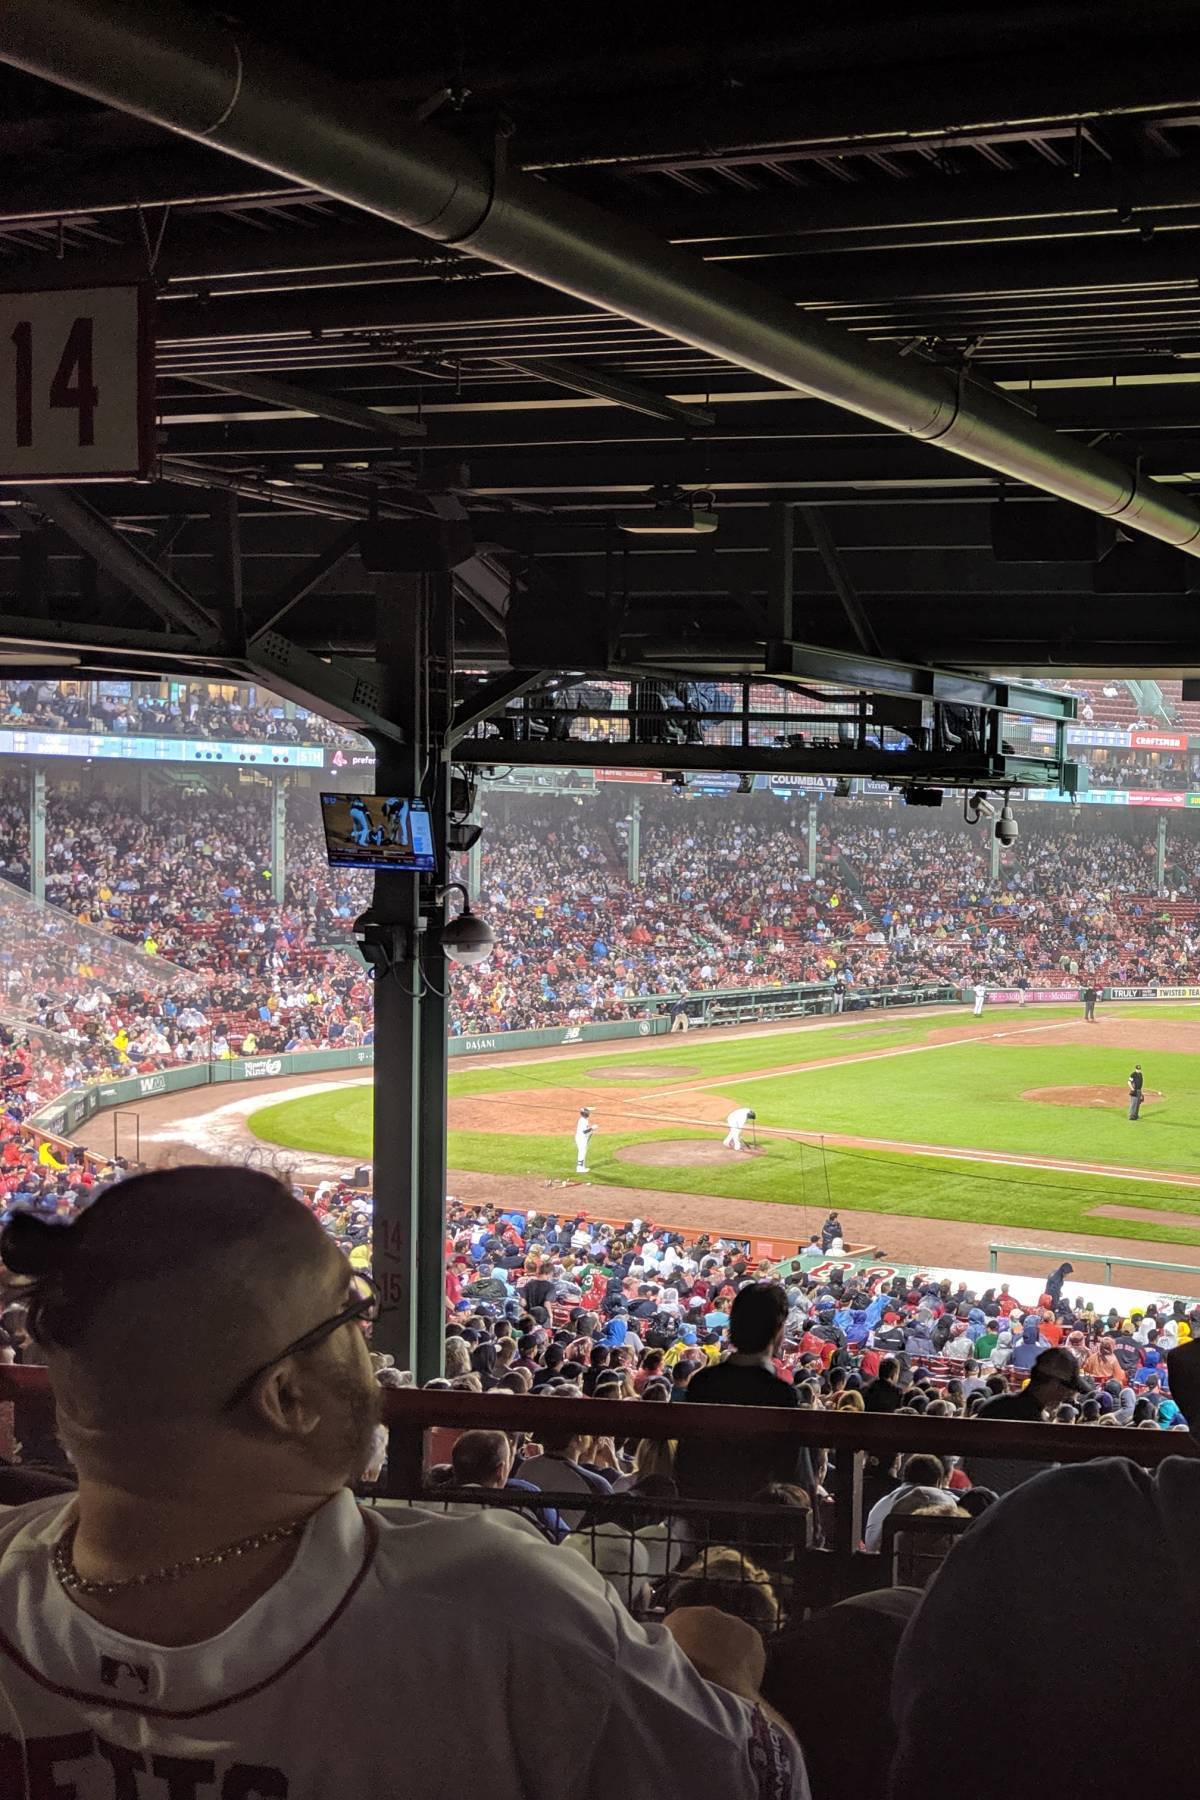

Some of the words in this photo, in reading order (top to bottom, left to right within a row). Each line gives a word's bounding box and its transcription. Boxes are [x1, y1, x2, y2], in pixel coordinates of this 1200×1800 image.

[11, 318, 99, 447] 14
[1135, 737, 1181, 747] CRAFTSMAN
[771, 775, 824, 787] COLUMBIA
[826, 778, 839, 787] TE
[465, 1039, 496, 1050] DASANI
[381, 1220, 402, 1250] 14
[381, 1274, 403, 1302] 15
